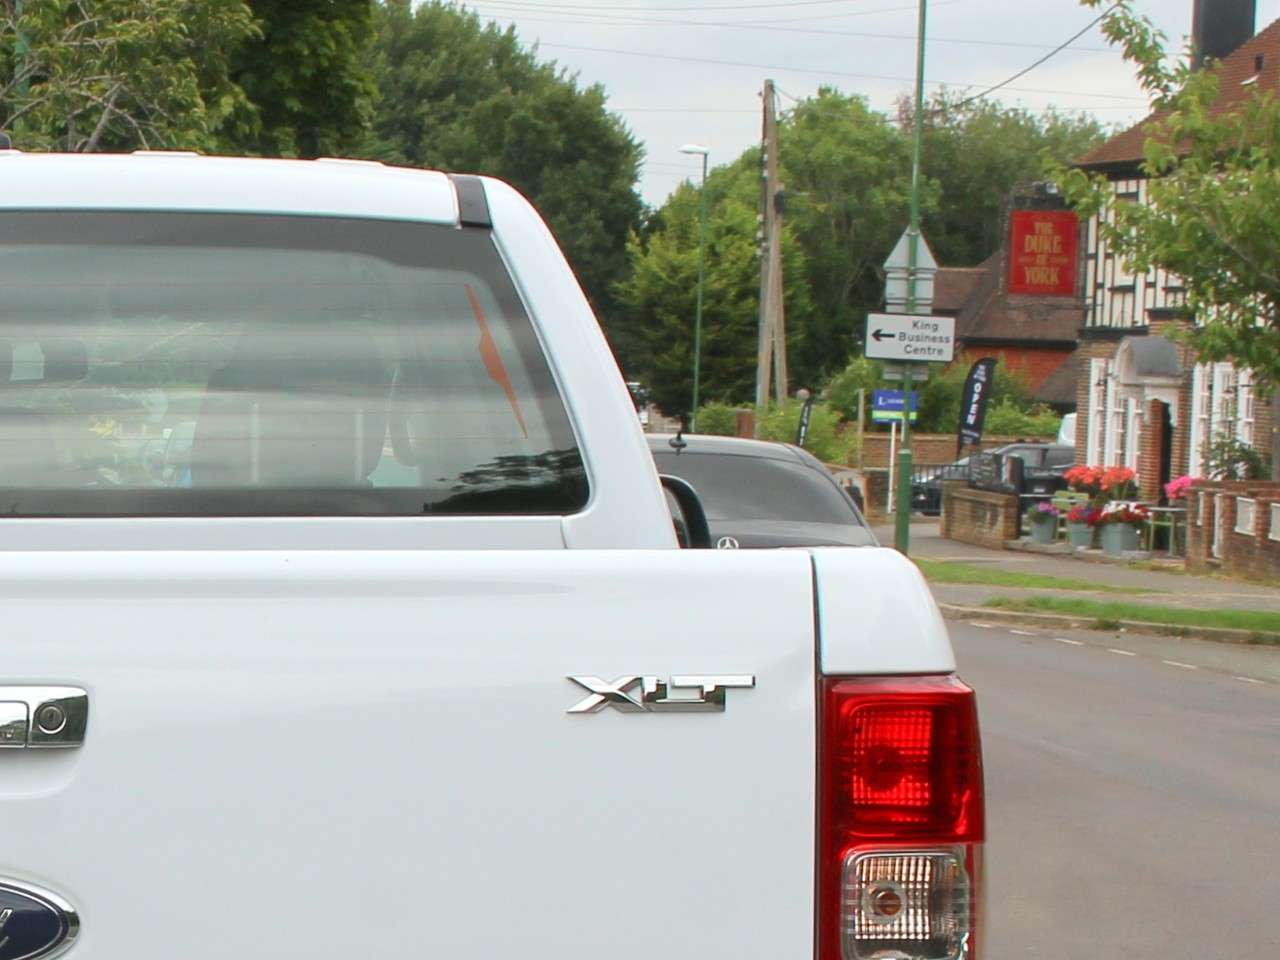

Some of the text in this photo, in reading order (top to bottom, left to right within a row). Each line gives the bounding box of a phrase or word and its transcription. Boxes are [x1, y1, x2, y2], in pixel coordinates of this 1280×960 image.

[1024, 234, 1062, 253] DUKE
[1024, 266, 1060, 285] YORK
[912, 320, 939, 332] King
[898, 331, 950, 344] Business
[903, 344, 944, 356] Centre
[966, 382, 983, 425] OPEN
[566, 674, 756, 713] XLT
